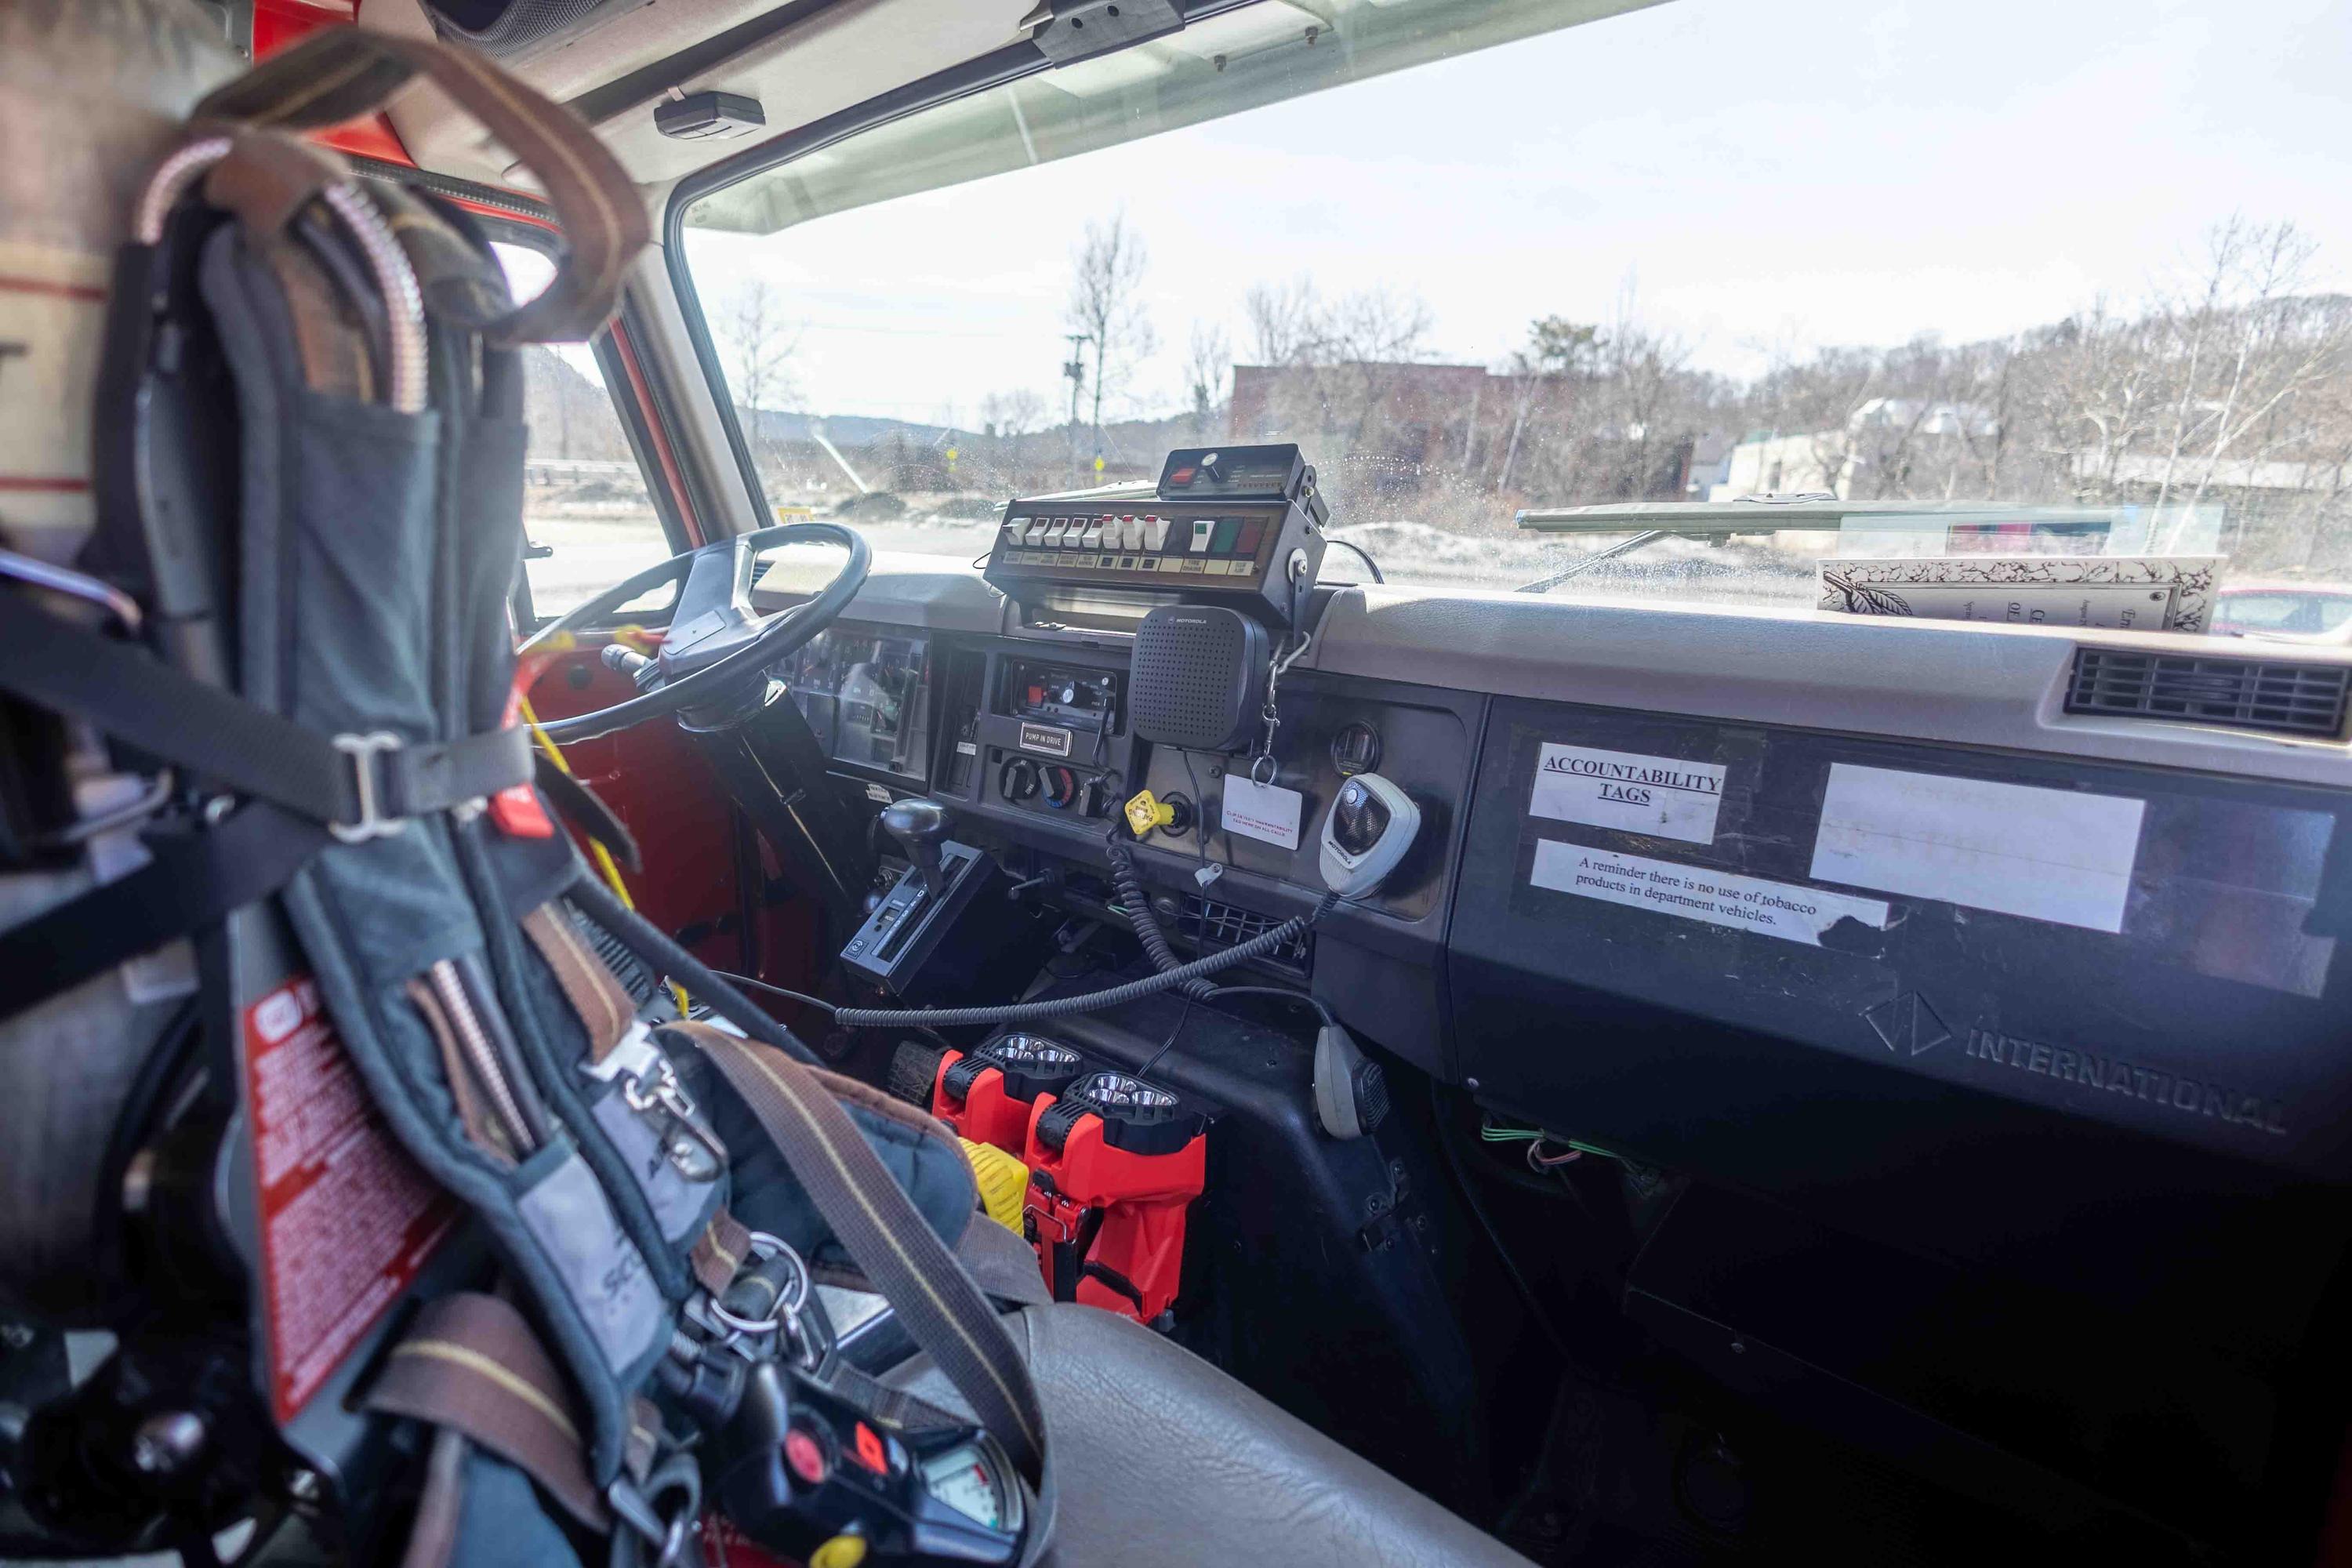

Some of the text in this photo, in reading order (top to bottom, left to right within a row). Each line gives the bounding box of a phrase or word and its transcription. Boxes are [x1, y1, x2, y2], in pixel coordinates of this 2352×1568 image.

[1025, 732, 1062, 746] PUMP IN DRIVE
[1544, 756, 1722, 792] ACCOUNTABILITY
[1599, 782, 1652, 804] TAGS
[1327, 840, 1352, 865] MOTOROLA
[1576, 874, 1777, 925] products in department vehicles.
[1579, 857, 1817, 915] A reminder there is no use of tobacco
[1965, 1028, 2287, 1135] INTERNATIONAL
